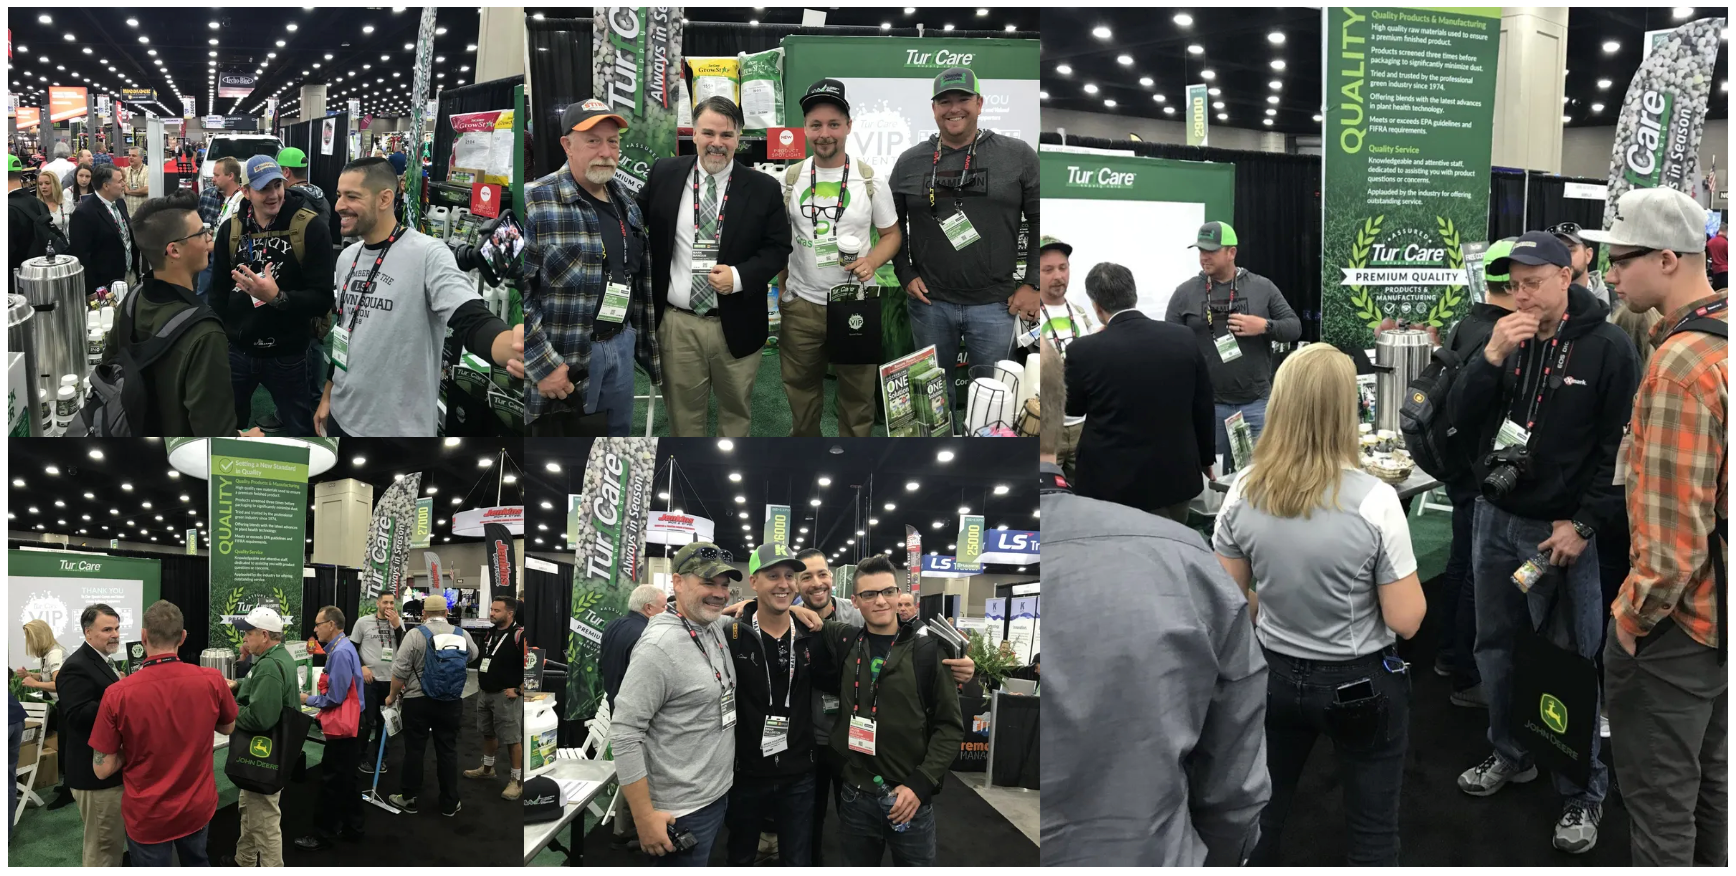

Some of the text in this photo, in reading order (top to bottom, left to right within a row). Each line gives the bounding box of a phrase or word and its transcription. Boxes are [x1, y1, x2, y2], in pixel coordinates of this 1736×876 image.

[1372, 10, 1398, 21] Quality
[1399, 12, 1430, 22] Products
[1439, 16, 1486, 30] Manufacturing
[1372, 23, 1385, 31] High
[1387, 25, 1407, 33] quality
[1421, 27, 1446, 36] materials
[1376, 34, 1402, 43] premium
[1404, 35, 1426, 44] finished
[905, 49, 972, 66] TurfCare
[1371, 47, 1397, 56] Products
[1399, 49, 1425, 57] screened
[1459, 53, 1477, 61] before
[650, 26, 669, 104] Always in
[1371, 56, 1400, 66] packaging
[1409, 59, 1443, 68] significantly
[1445, 62, 1469, 70] minimize
[1340, 7, 1367, 154] QUALITY
[1388, 81, 1412, 89] industry
[1421, 73, 1428, 81] by
[1440, 75, 1474, 83] professional
[983, 94, 1009, 105] YOU
[1370, 93, 1394, 102] Offering
[1377, 103, 1391, 111] plant
[1433, 120, 1460, 128] guidelines
[1672, 108, 1691, 161] Season
[853, 131, 904, 156] VIP
[1369, 145, 1419, 154] Quality Service
[1369, 157, 1412, 165] Knowledgeable
[1067, 169, 1135, 189] TurfCare
[1367, 189, 1398, 197] Applauded
[1399, 189, 1406, 197] by
[1418, 190, 1440, 198] industry
[1451, 191, 1471, 199] offering
[1367, 198, 1401, 206] outstanding
[1392, 229, 1428, 239] ASSURED
[1372, 244, 1445, 261] TurfCare
[1356, 273, 1459, 282] PREMIUM QUALITY
[886, 374, 909, 392] ONE
[927, 379, 943, 394] ONE
[888, 387, 910, 401] Solution
[218, 476, 234, 555] QUALITY
[417, 506, 428, 536] 27000
[587, 453, 623, 580] TurfCare
[623, 476, 644, 577] Always in Season
[966, 524, 980, 556] 25000
[998, 532, 1028, 550] LS
[774, 543, 789, 557] K
[495, 540, 510, 586] Jenkins
[930, 557, 953, 569] LS
[576, 624, 601, 640] PREMIU
[1524, 719, 1578, 760] JOHN DEERE
[235, 756, 279, 770] JOHN DEERE
